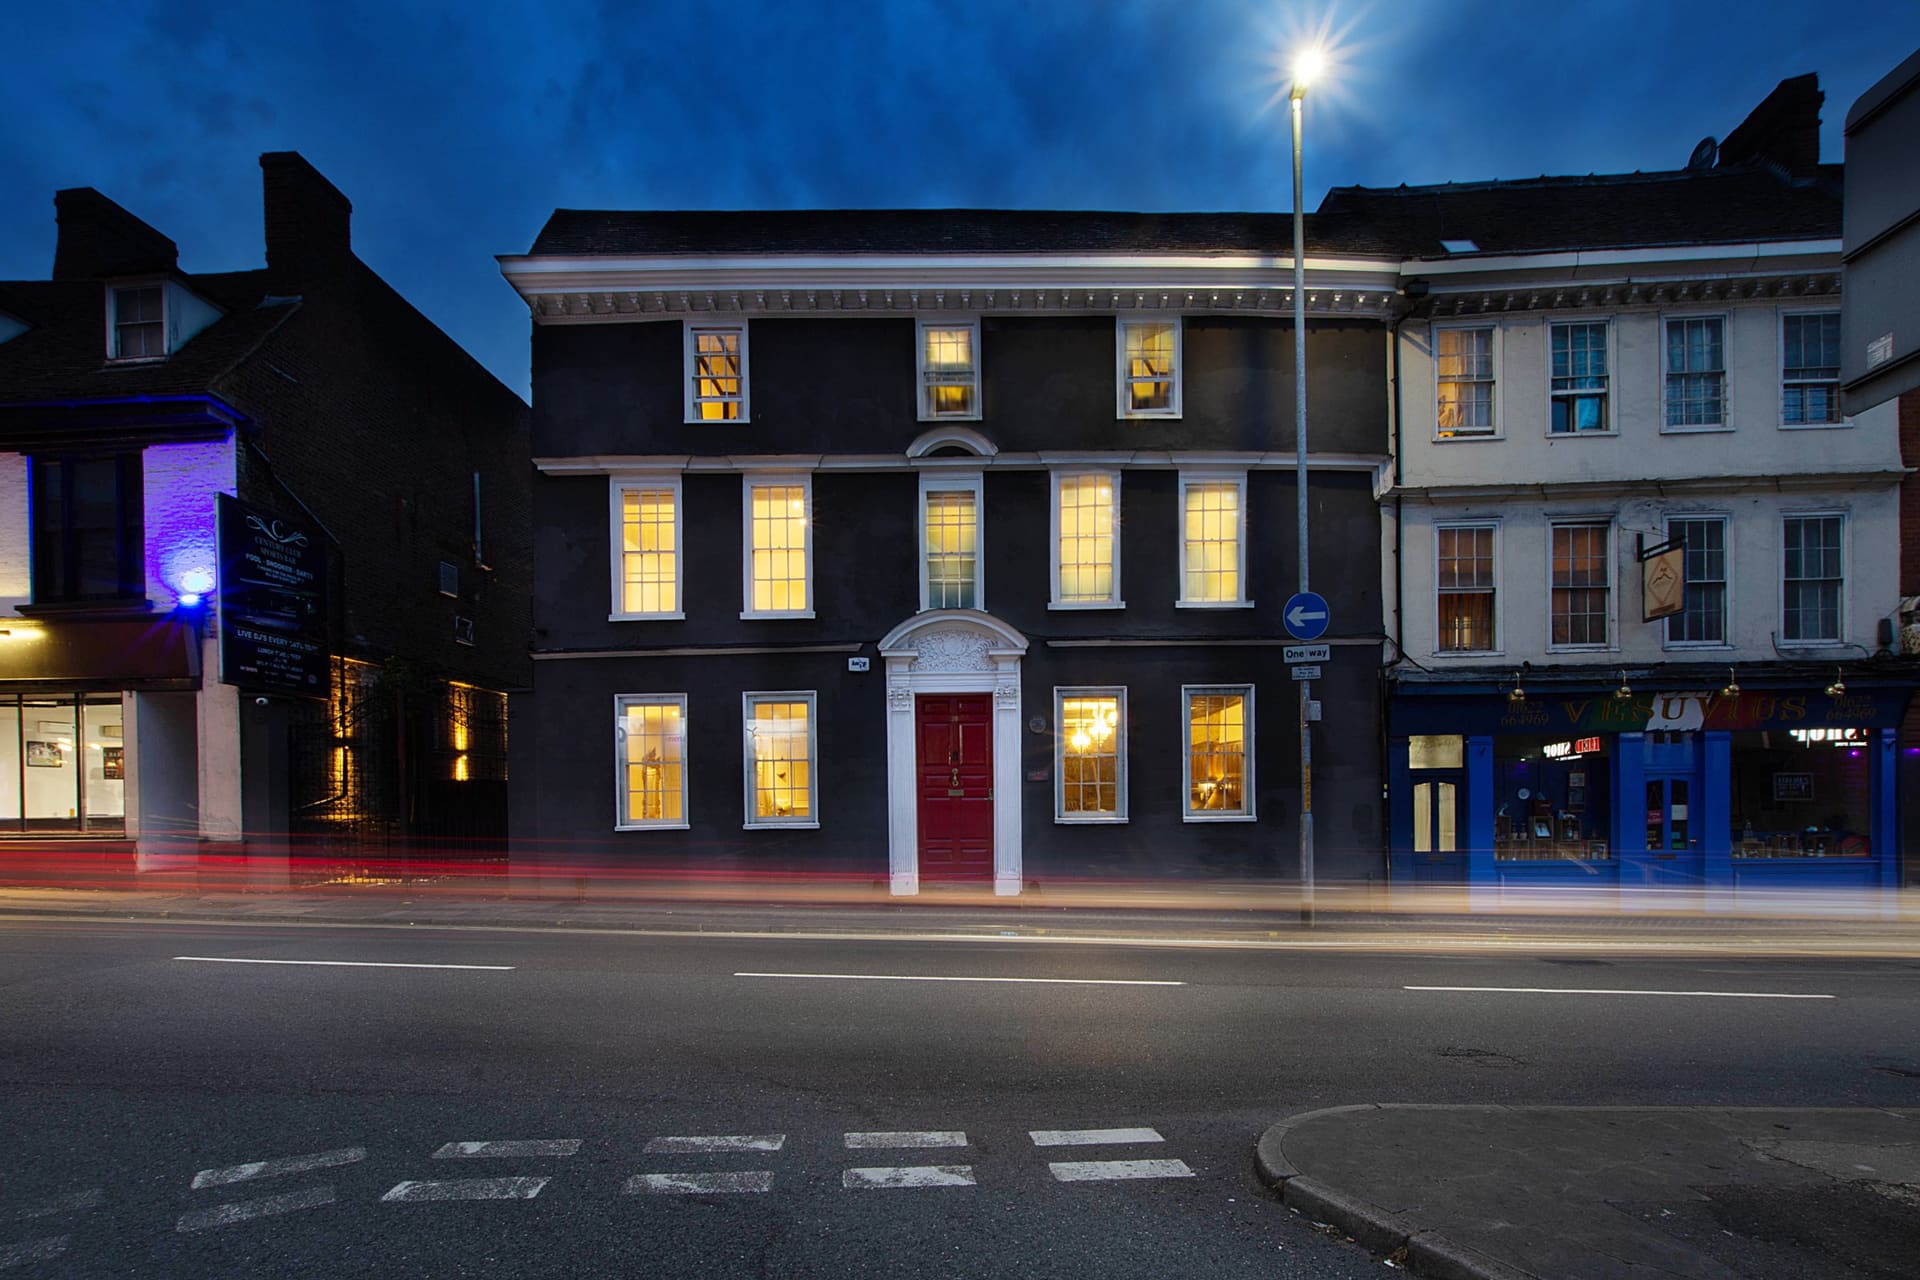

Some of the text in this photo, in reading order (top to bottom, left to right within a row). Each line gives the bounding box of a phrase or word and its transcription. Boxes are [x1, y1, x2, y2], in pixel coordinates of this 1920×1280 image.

[245, 553, 262, 563] POOL
[266, 559, 293, 574] SNOOKER
[237, 629, 252, 639] LIVE
[253, 632, 267, 642] DJ'S
[268, 635, 287, 646] EVERY
[1286, 649, 1327, 658] One way
[1560, 695, 1808, 723] VESUVIUS
